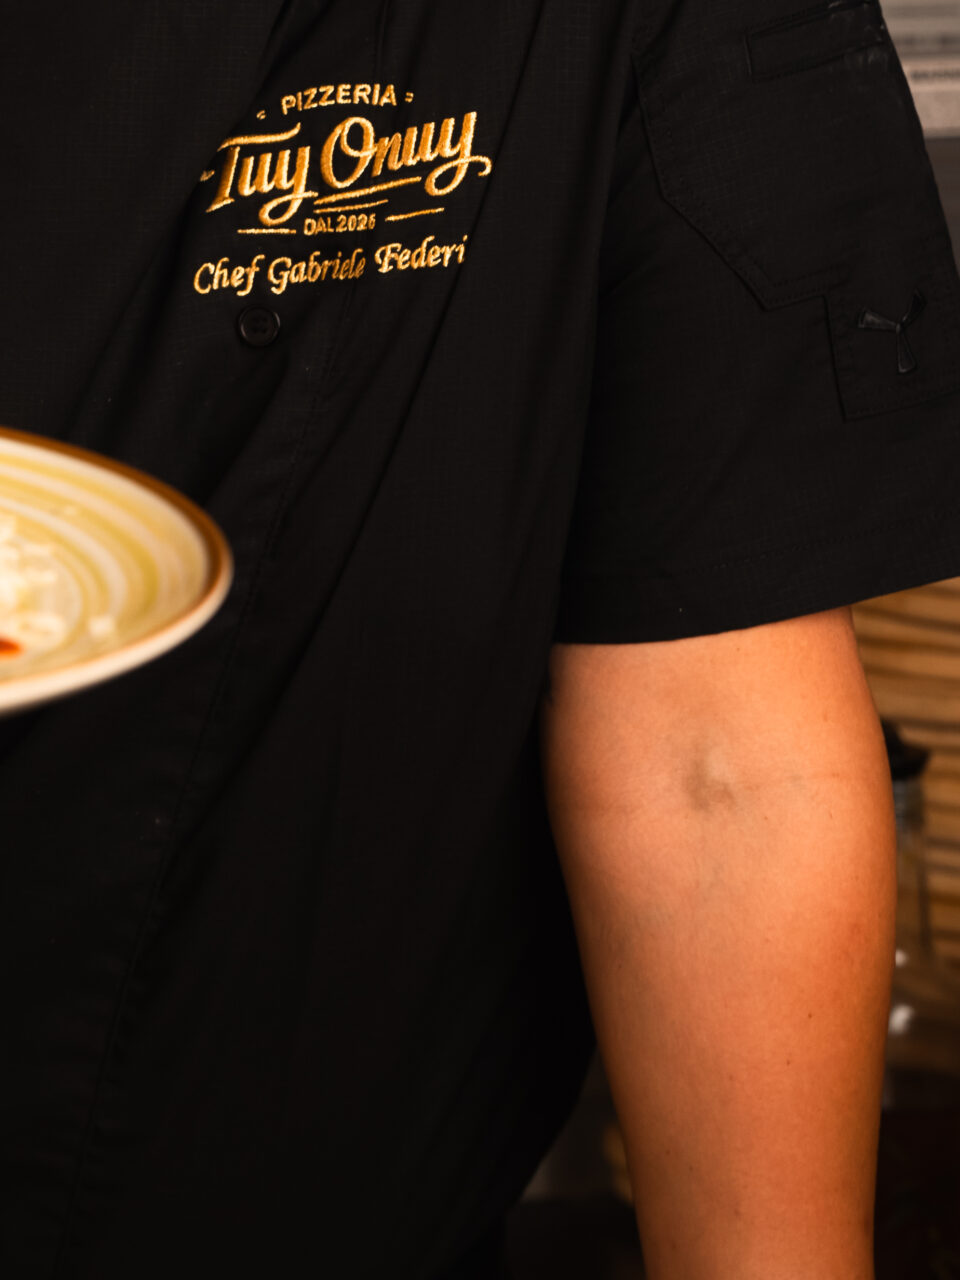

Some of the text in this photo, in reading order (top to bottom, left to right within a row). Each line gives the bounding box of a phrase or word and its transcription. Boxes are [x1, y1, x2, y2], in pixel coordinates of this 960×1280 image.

[280, 83, 398, 116] PIZZERIA
[193, 254, 266, 297] Chef
[267, 248, 366, 295] Gabriele
